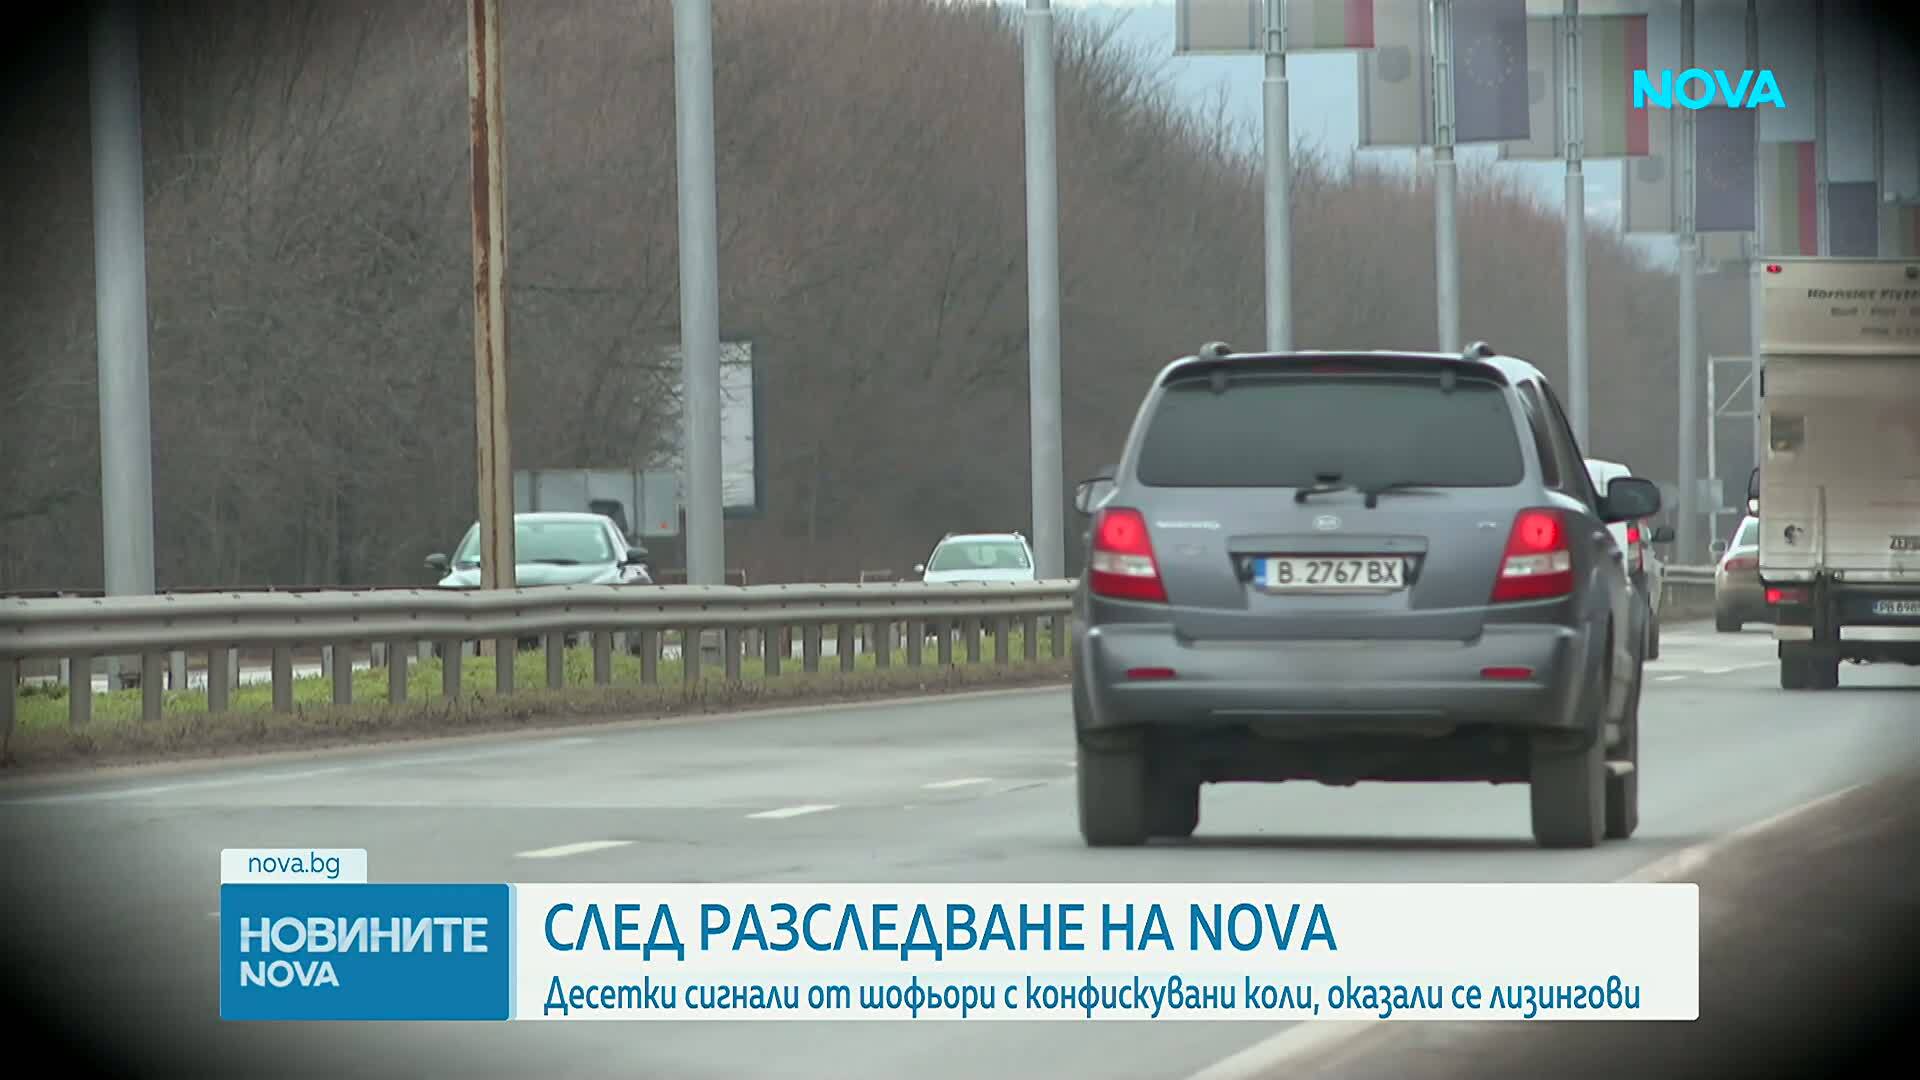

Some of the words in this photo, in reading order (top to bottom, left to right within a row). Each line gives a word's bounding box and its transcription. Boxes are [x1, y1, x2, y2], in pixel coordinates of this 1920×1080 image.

[1278, 561, 1293, 584] B
[1306, 561, 1362, 584] 2767
[1367, 561, 1398, 584] BX
